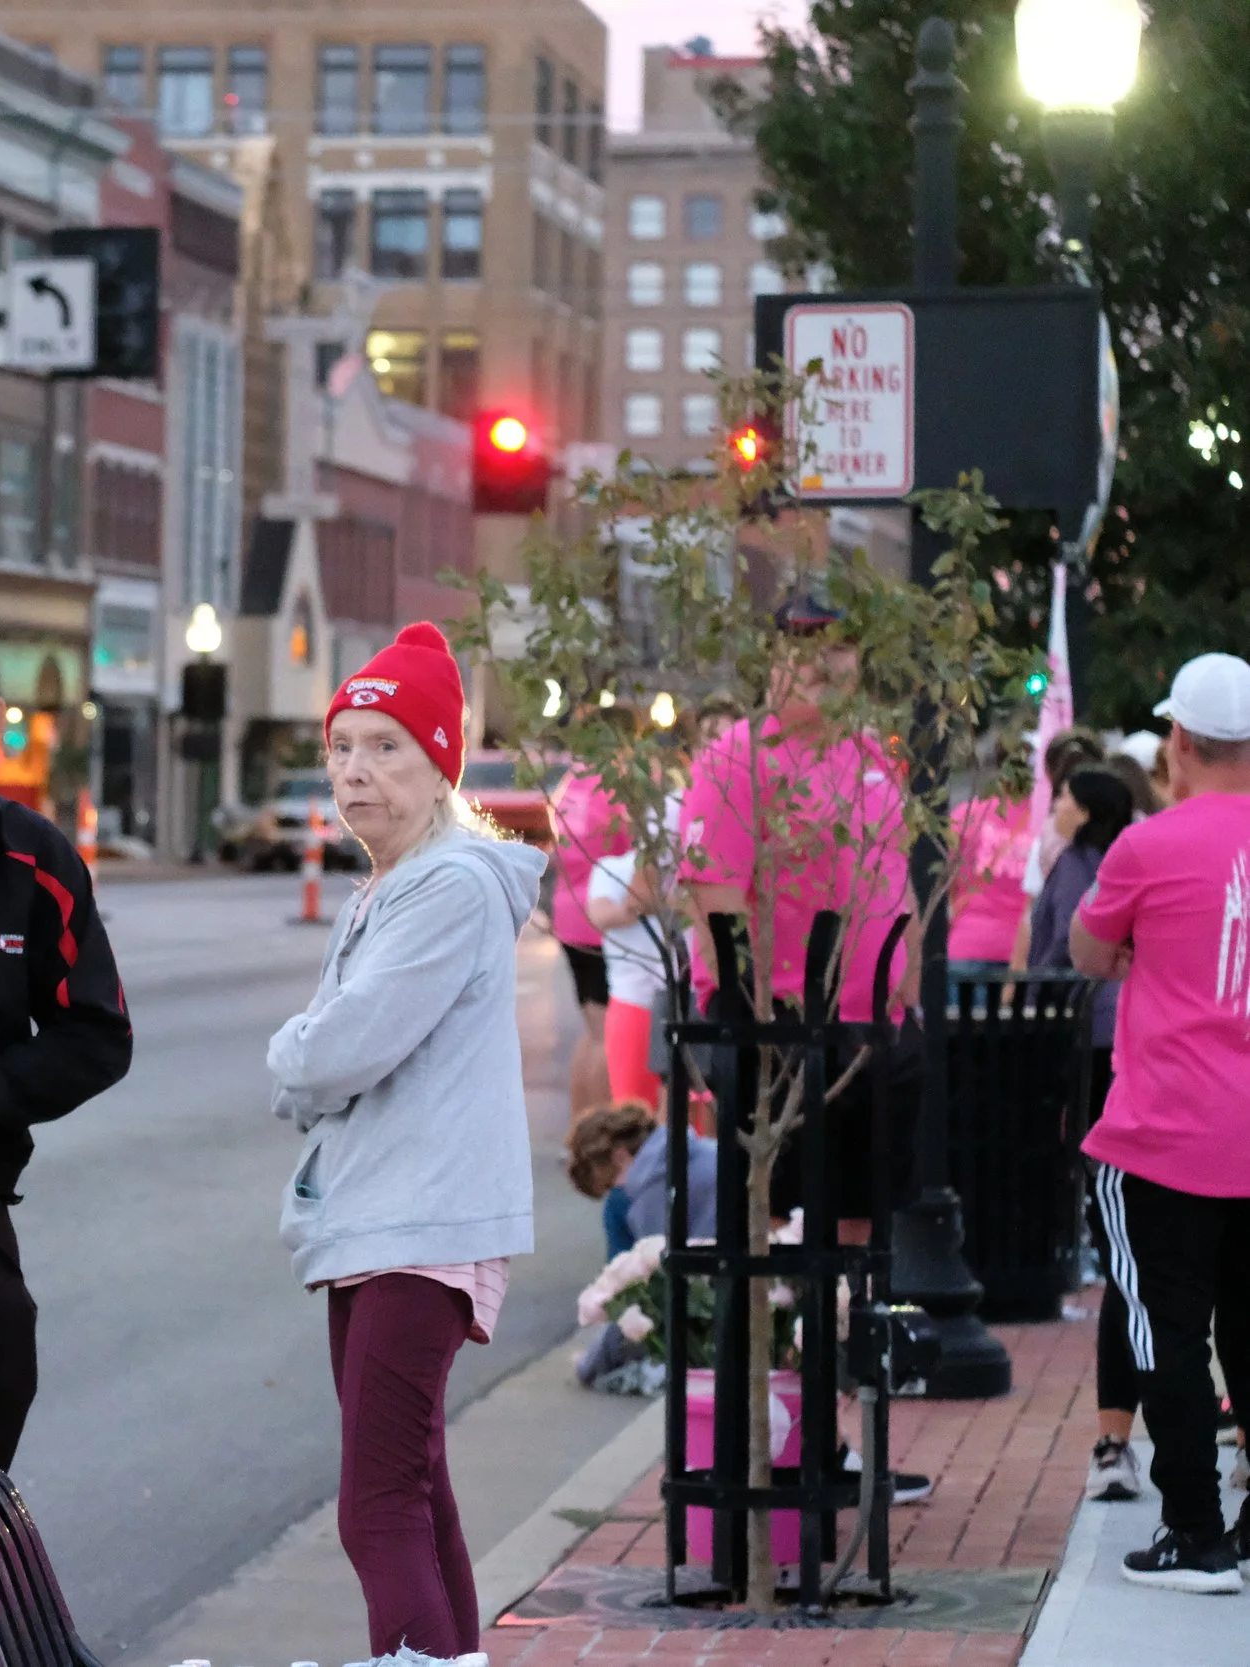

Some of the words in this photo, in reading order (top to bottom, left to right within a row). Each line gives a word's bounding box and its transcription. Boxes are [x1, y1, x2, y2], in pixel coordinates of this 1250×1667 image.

[831, 326, 868, 360] NO
[806, 365, 901, 393] ARKING
[839, 424, 862, 449] TO
[346, 679, 398, 697] CHAMPIONS
